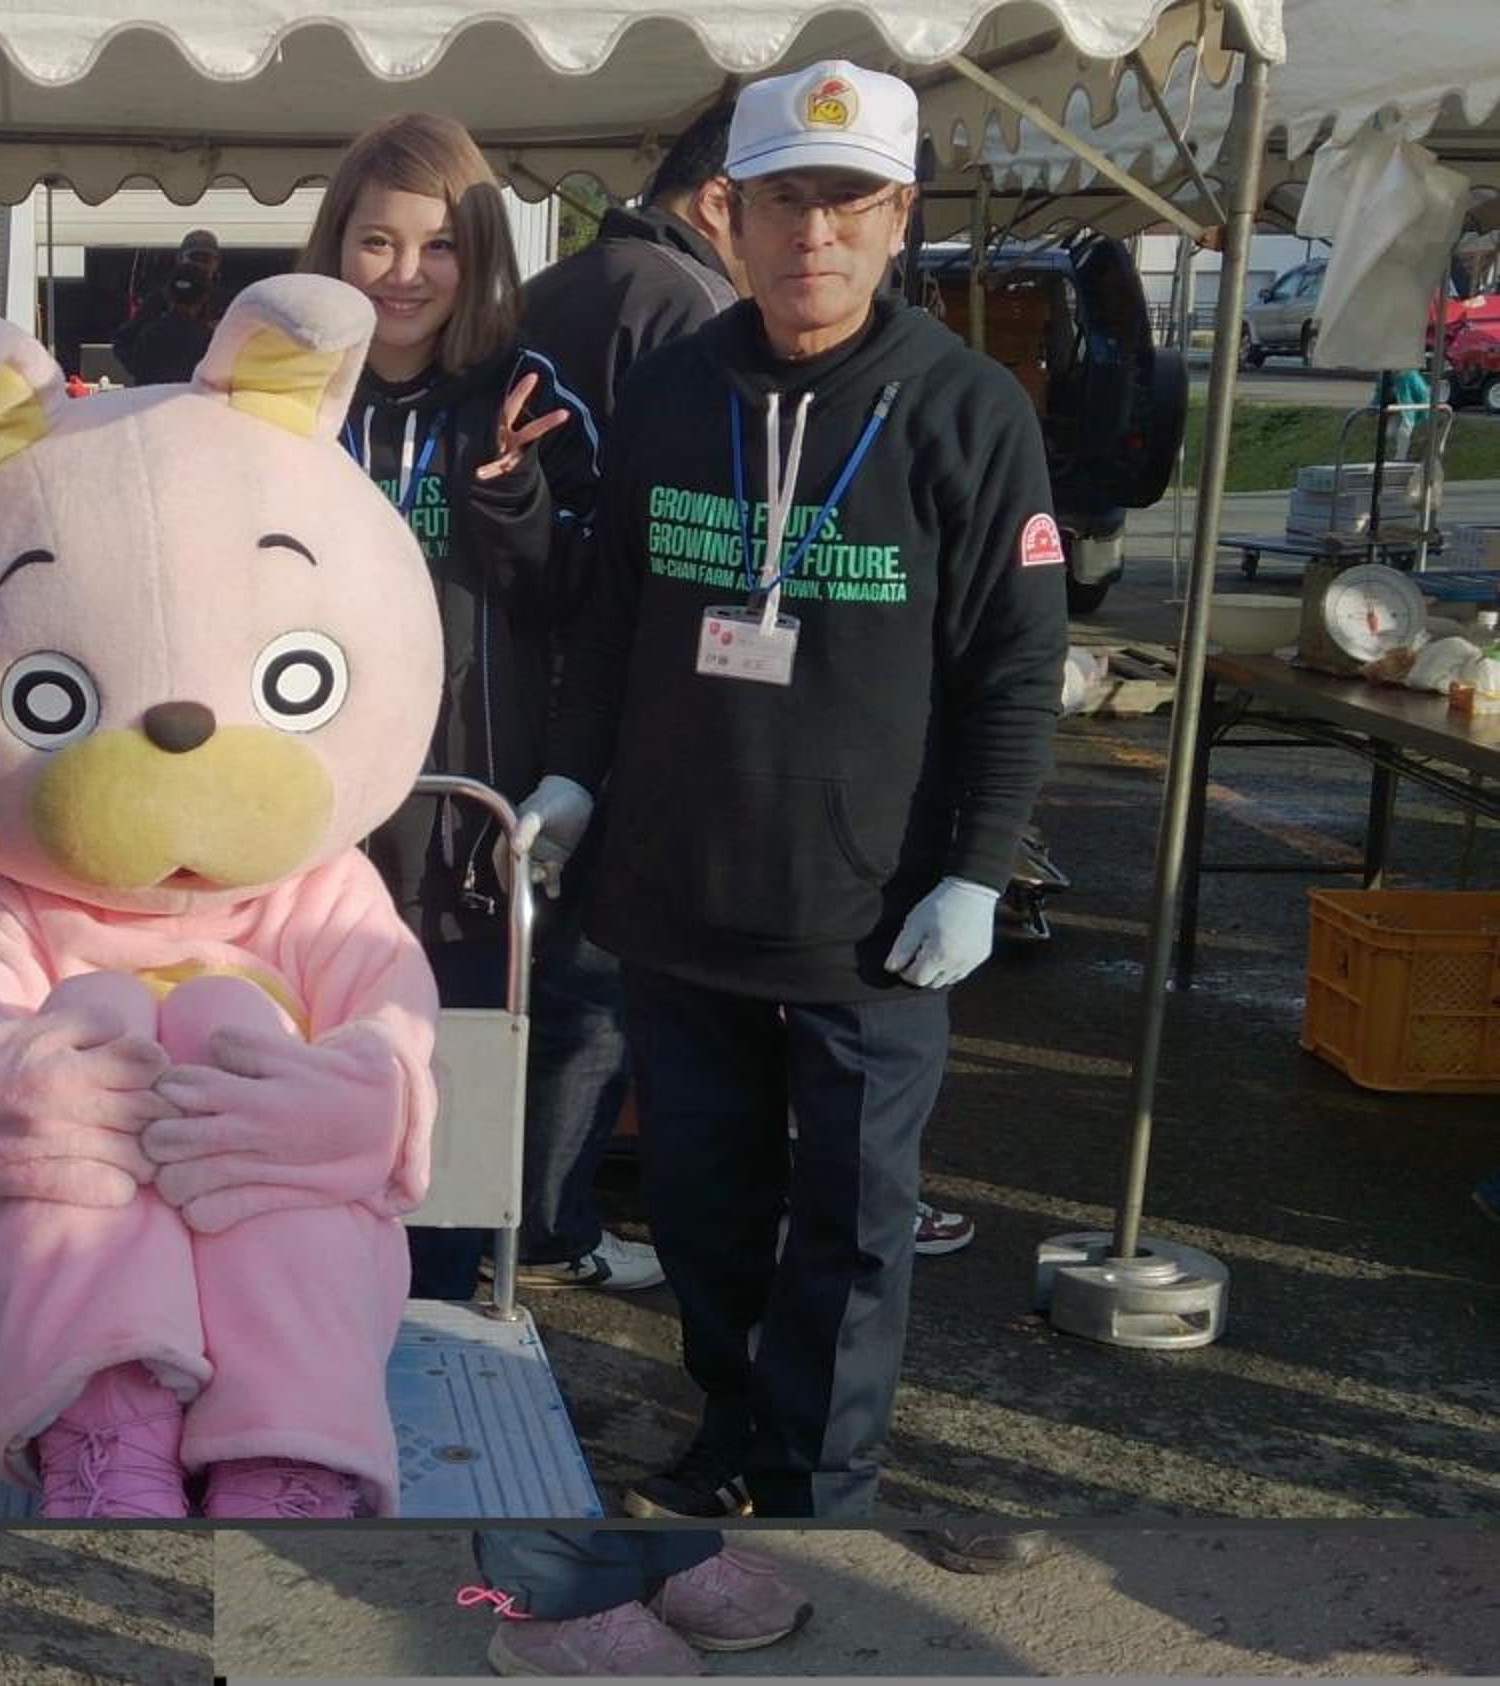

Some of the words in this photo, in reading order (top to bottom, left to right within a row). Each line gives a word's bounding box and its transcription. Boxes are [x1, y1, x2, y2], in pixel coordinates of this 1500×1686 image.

[649, 485, 750, 532] GROWING
[753, 501, 844, 541] FUITS.
[648, 521, 744, 568] GROWING
[751, 537, 797, 576] TE
[801, 543, 907, 580] FUTURE.
[697, 564, 736, 589] FARM
[826, 580, 908, 602] YAMAGATA
